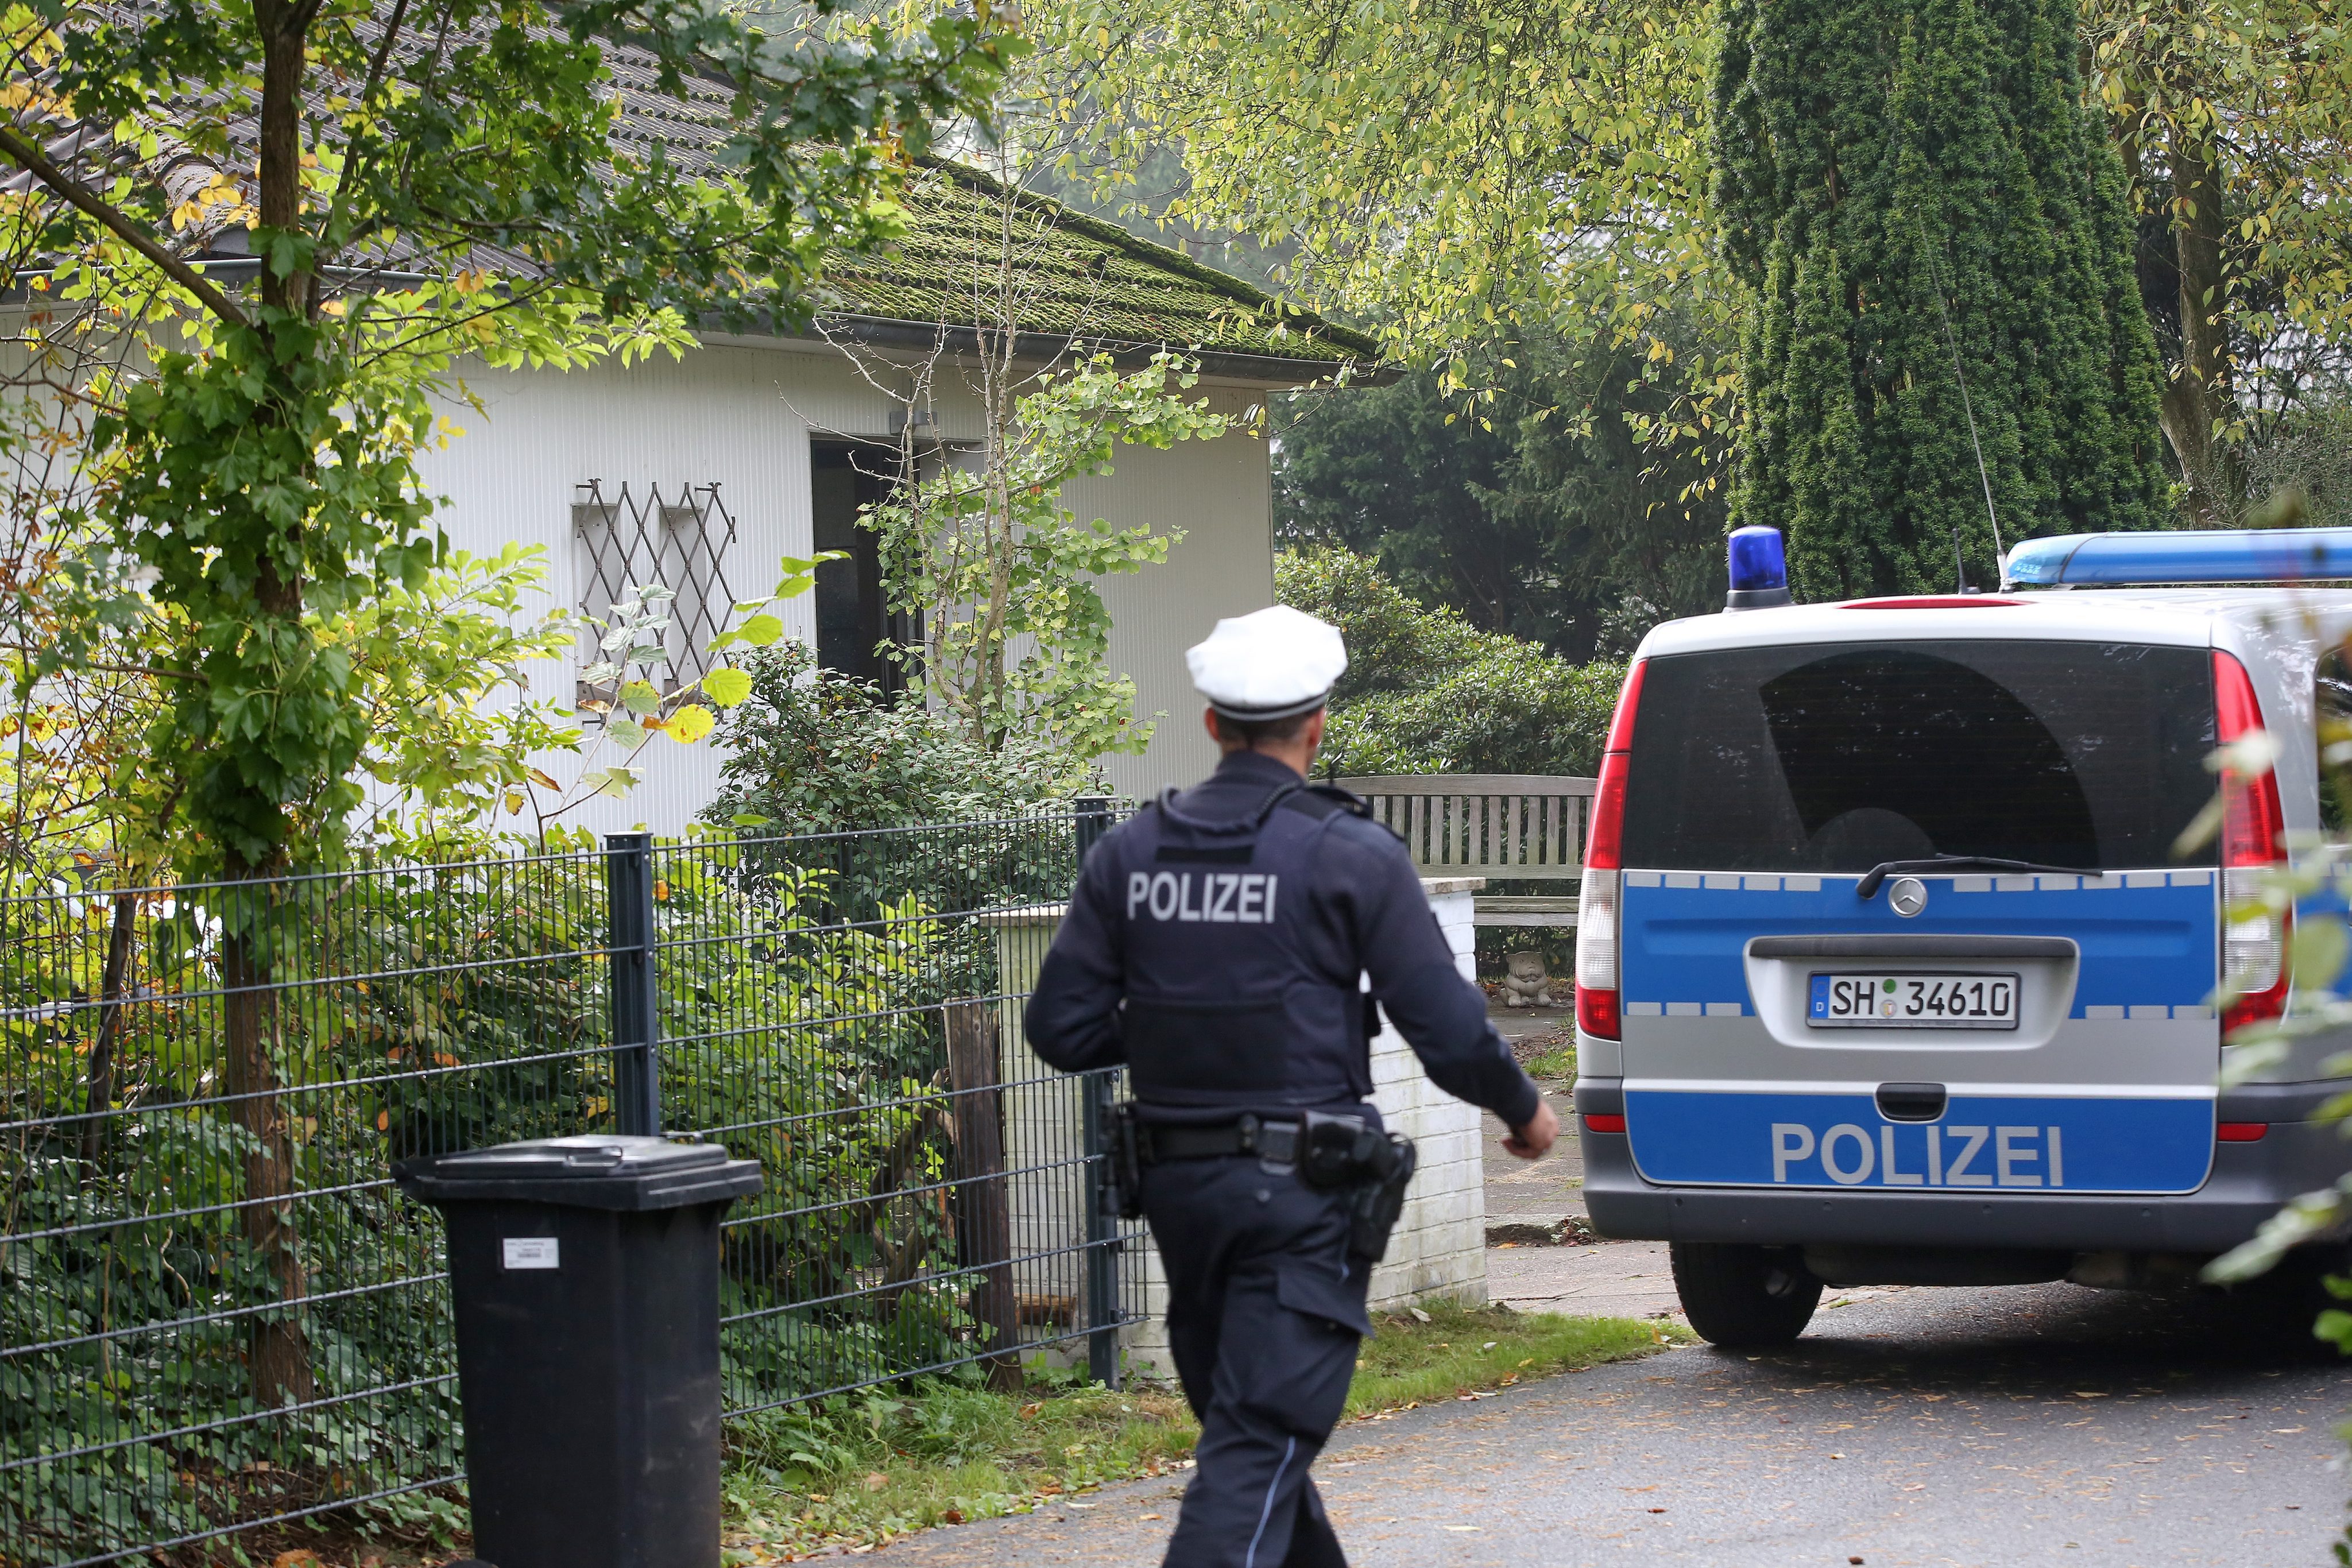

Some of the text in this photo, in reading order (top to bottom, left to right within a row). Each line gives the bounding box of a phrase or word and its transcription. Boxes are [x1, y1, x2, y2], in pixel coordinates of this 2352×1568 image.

[1128, 872, 1278, 923] POLIZEI
[1816, 1002, 1824, 1012] D
[1832, 981, 2010, 1016] SH 34610
[1772, 1124, 2063, 1187] POLIZEI
